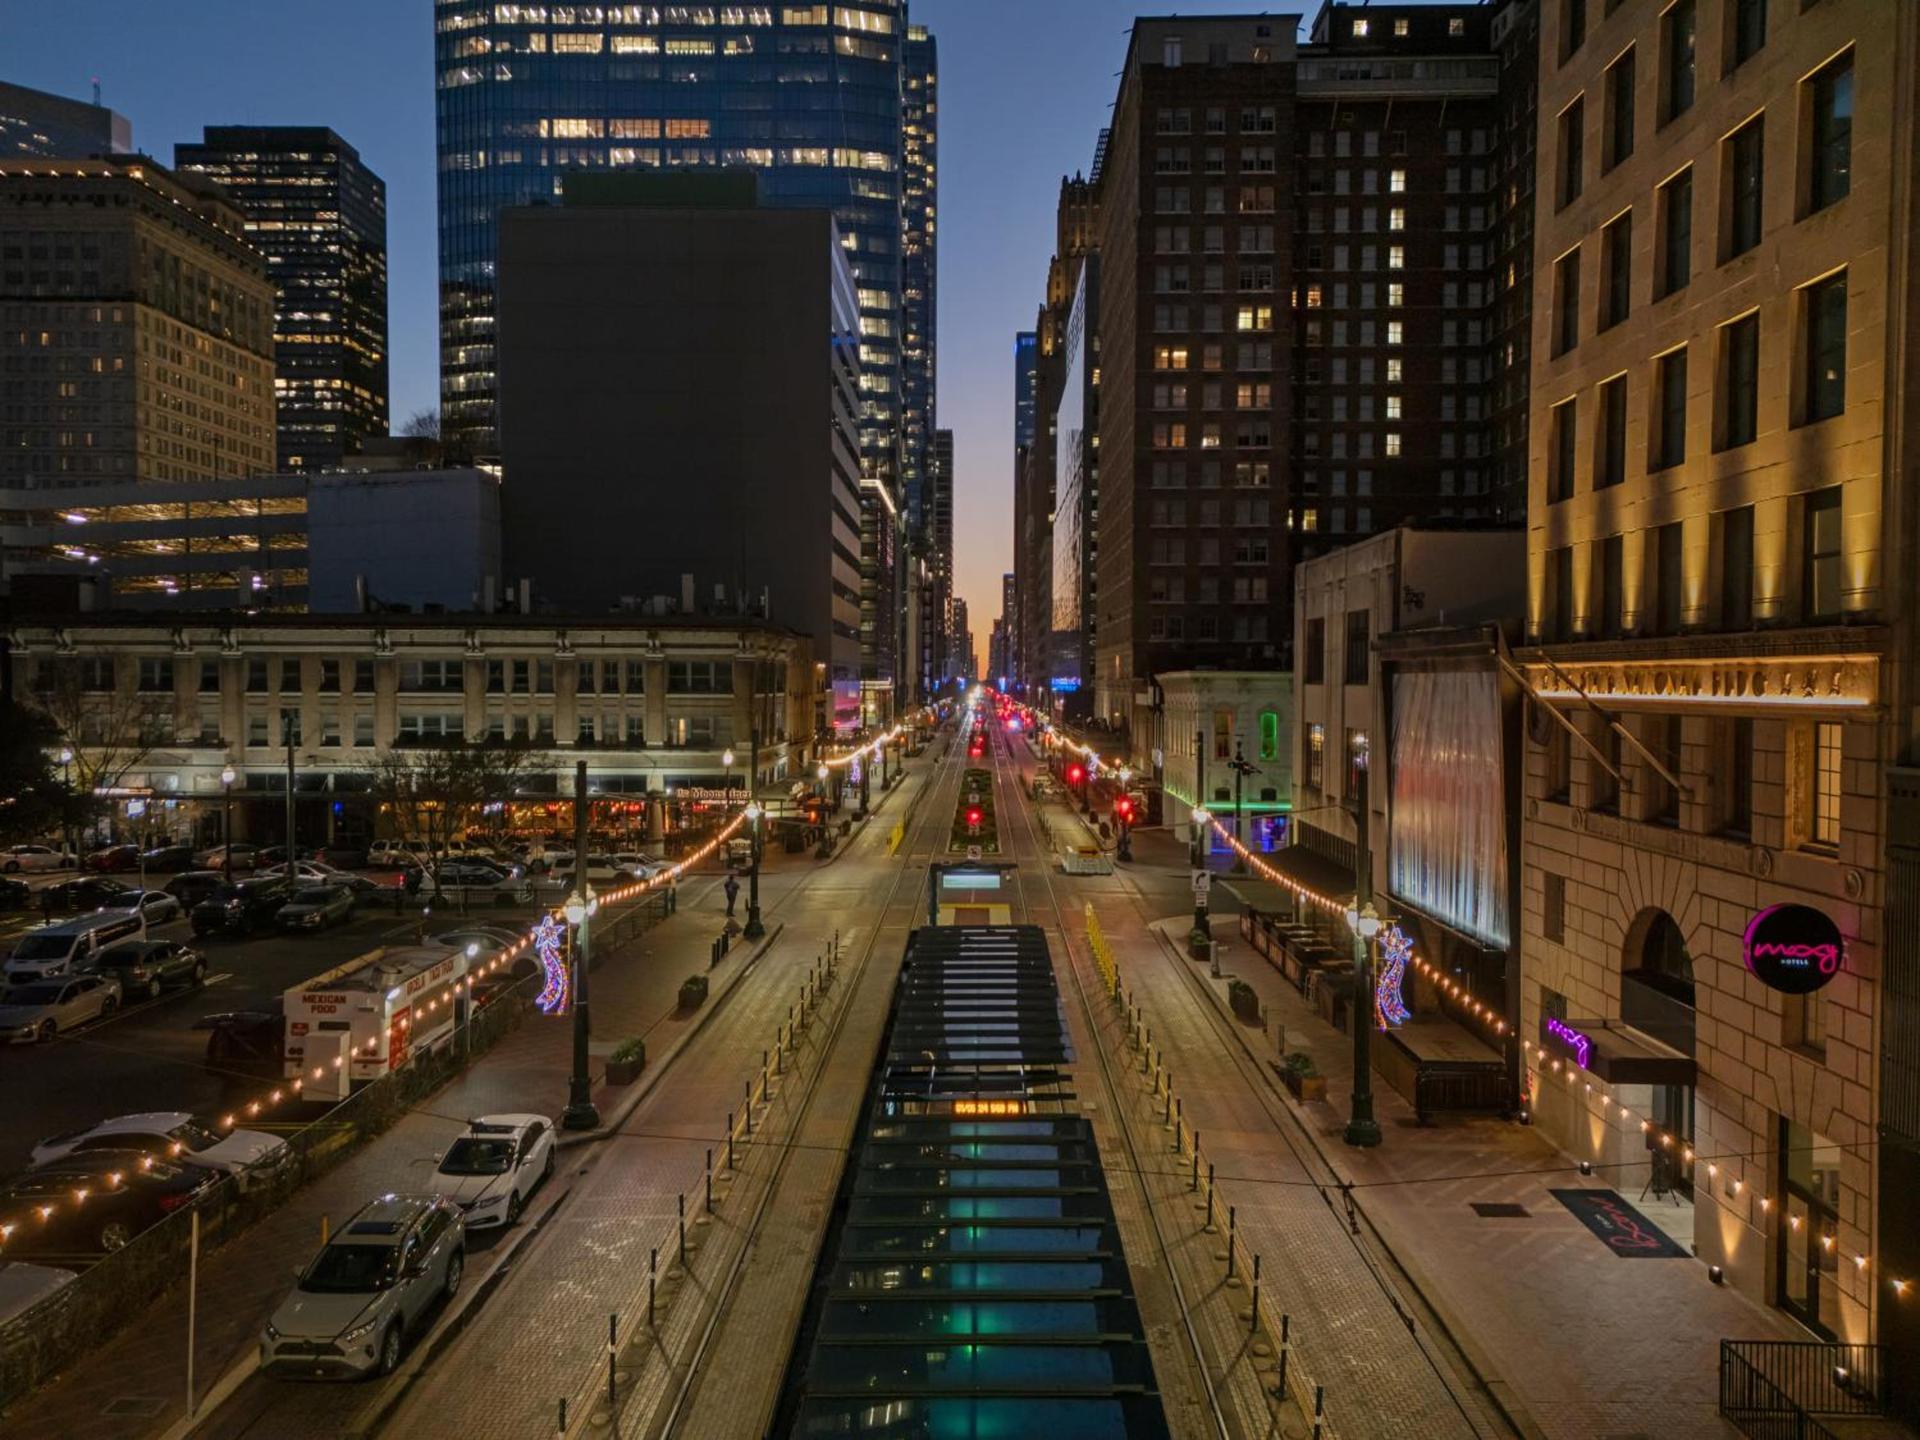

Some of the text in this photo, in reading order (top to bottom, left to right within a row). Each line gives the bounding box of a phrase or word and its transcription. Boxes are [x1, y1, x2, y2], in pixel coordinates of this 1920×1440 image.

[1754, 944, 1838, 974] moxy
[302, 995, 346, 1004] MEXICAN
[311, 1004, 337, 1014] FOOD
